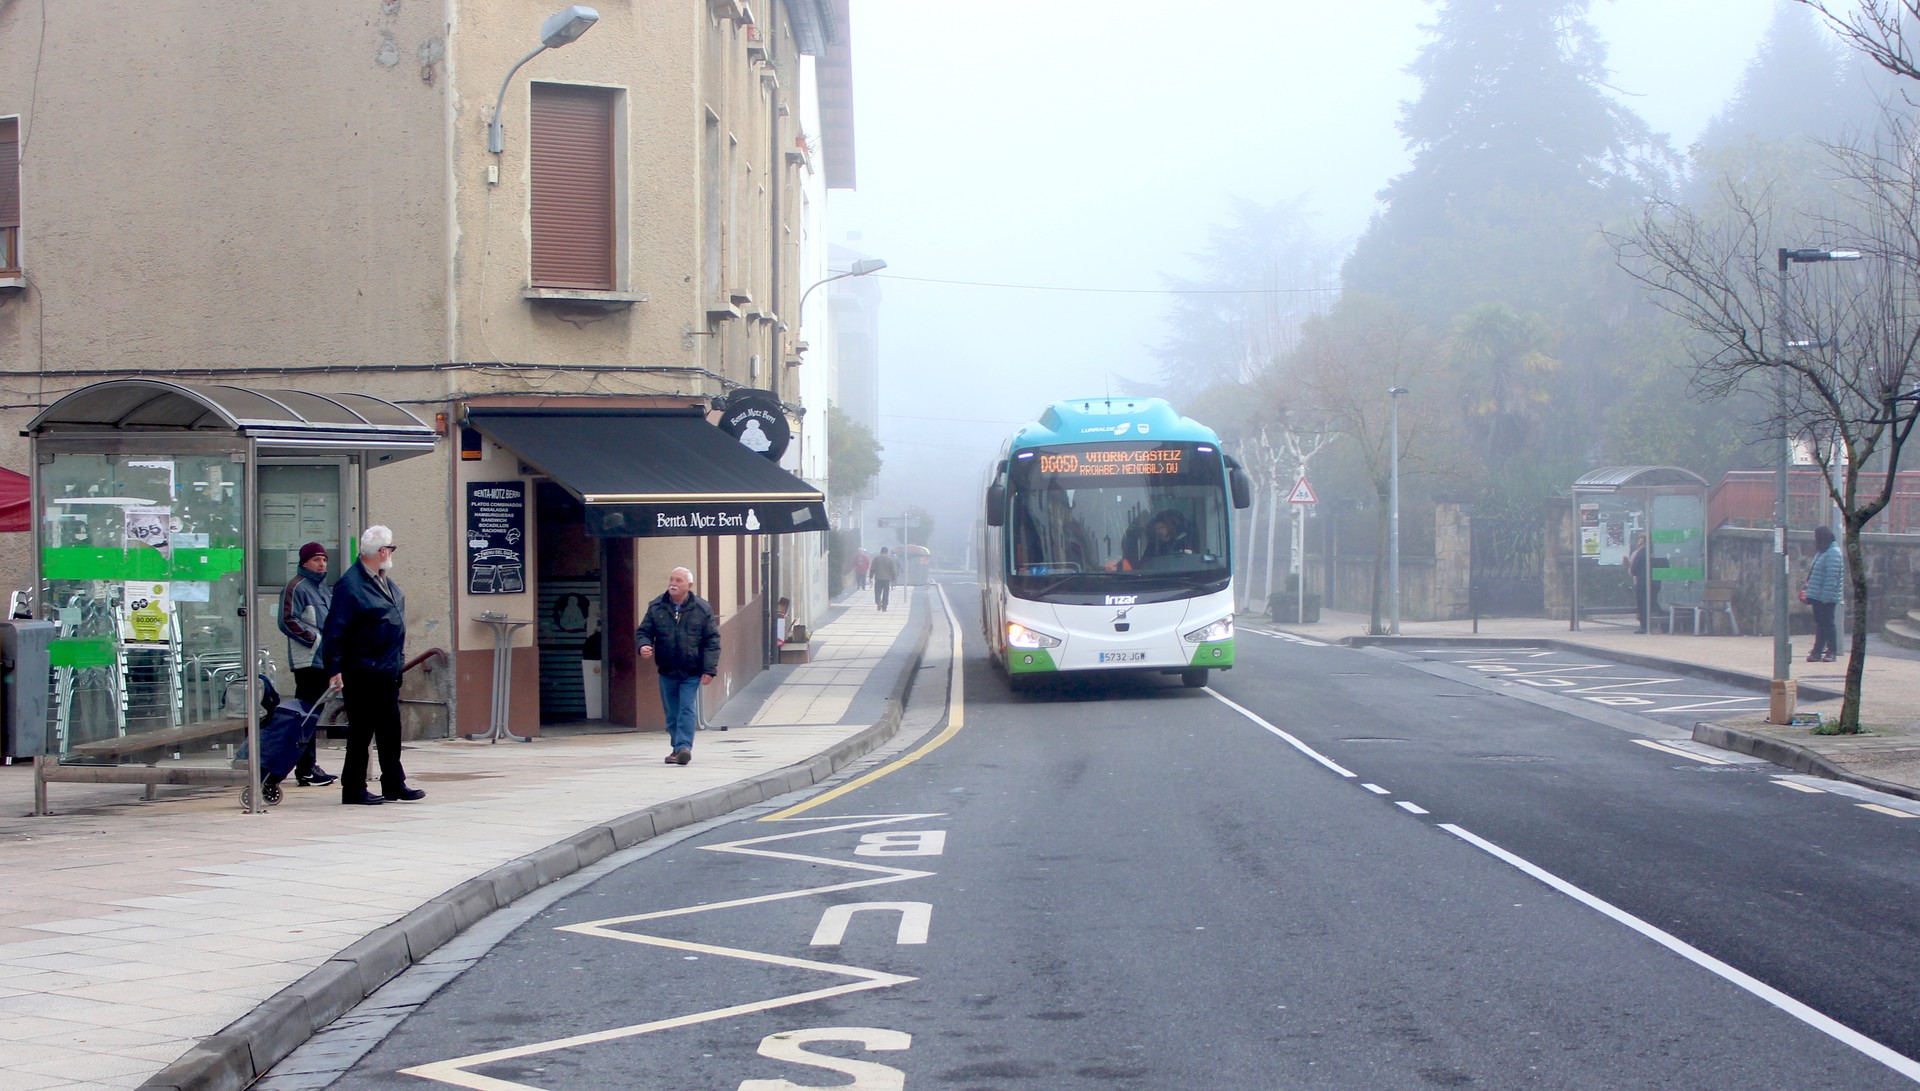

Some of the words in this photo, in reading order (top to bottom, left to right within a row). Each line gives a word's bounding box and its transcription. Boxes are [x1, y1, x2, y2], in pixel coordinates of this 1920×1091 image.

[730, 412, 747, 426] Benta
[747, 408, 762, 417] Motz
[762, 410, 776, 424] Berri
[1086, 450, 1181, 462] VITORIA/GASTEIZ
[657, 512, 687, 528] Benta
[690, 512, 716, 528] Motz
[718, 512, 743, 527] Berri
[1105, 652, 1127, 661] 5732
[1130, 652, 1145, 661] JGW
